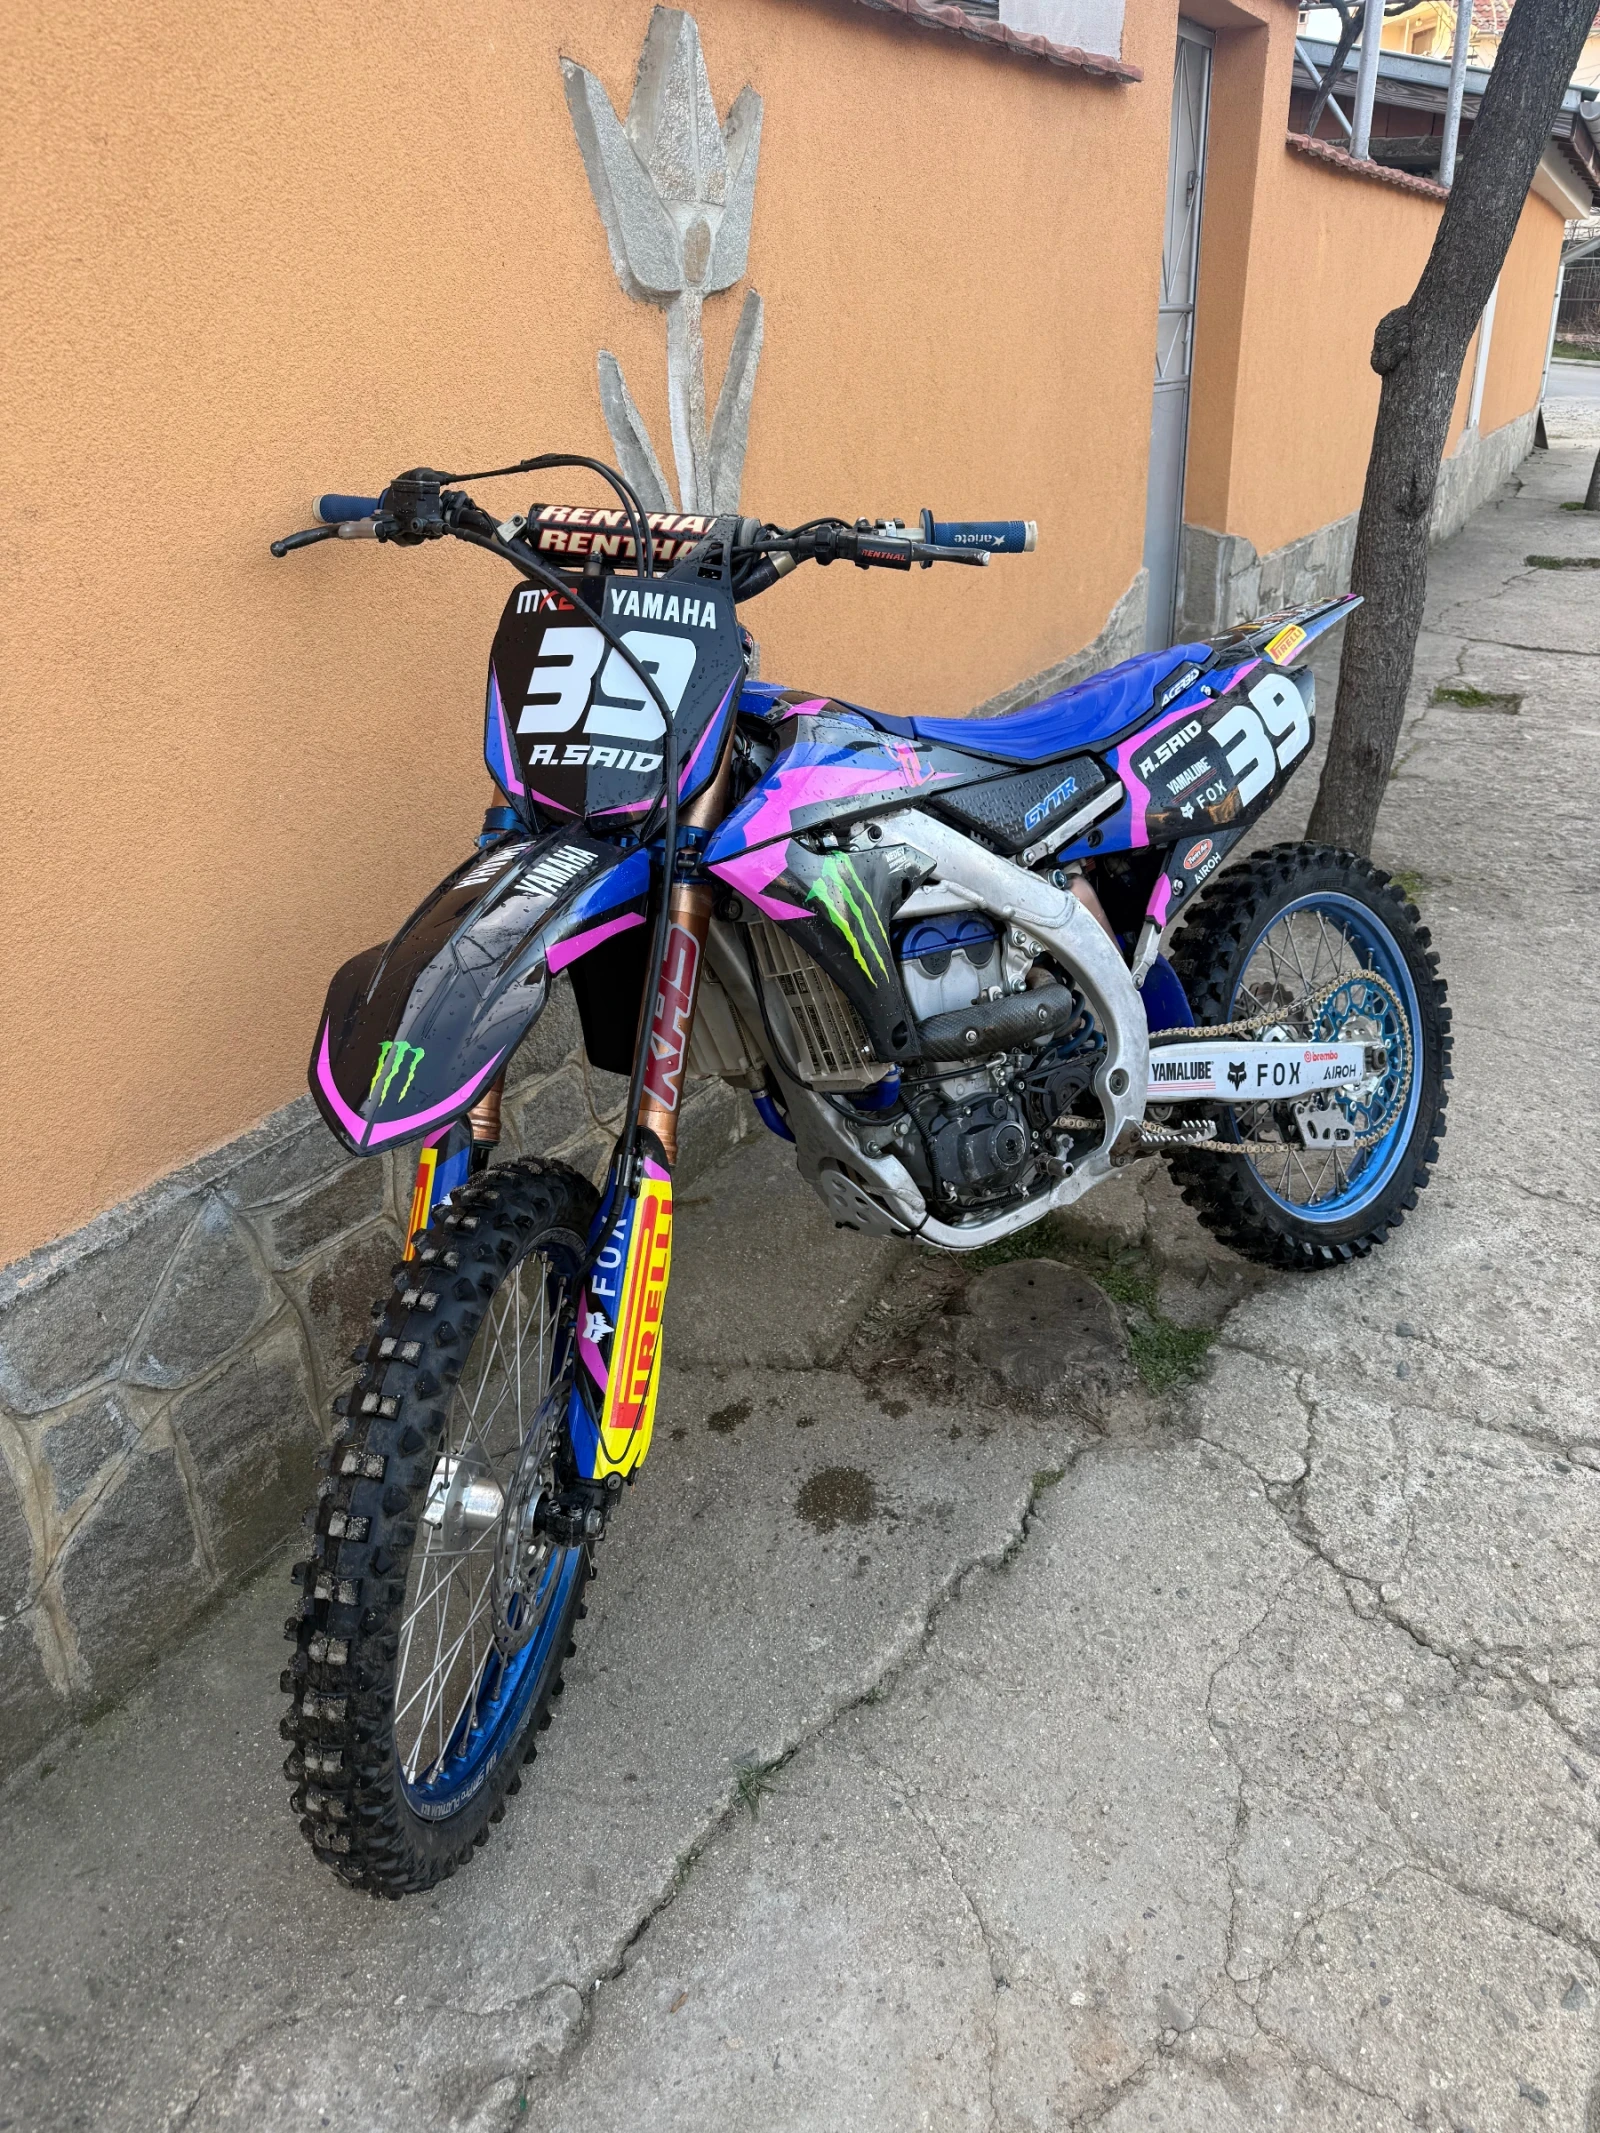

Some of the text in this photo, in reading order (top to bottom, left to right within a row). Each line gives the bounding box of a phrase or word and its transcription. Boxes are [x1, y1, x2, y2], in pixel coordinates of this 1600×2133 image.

[538, 528, 698, 560] RENTHA
[611, 588, 717, 630] YAMAHA
[1271, 626, 1303, 660] PIRELLI
[516, 626, 697, 742] 39
[528, 744, 664, 773] A.SAID
[1138, 719, 1202, 780] A.SAID
[1207, 673, 1311, 808] 39
[1166, 756, 1212, 796] YAMALUBE
[1196, 779, 1228, 810] FOX
[1024, 776, 1079, 832] GYTR
[514, 844, 599, 899] YAMAHA
[1194, 852, 1222, 885] AIROH
[1151, 1061, 1213, 1082] YAMALUBE
[1256, 1062, 1301, 1087] FOX
[1312, 1051, 1339, 1062] brembo
[1322, 1064, 1357, 1081] AIROH
[591, 1215, 627, 1297] FOX
[609, 1195, 673, 1430] PIRELLI
